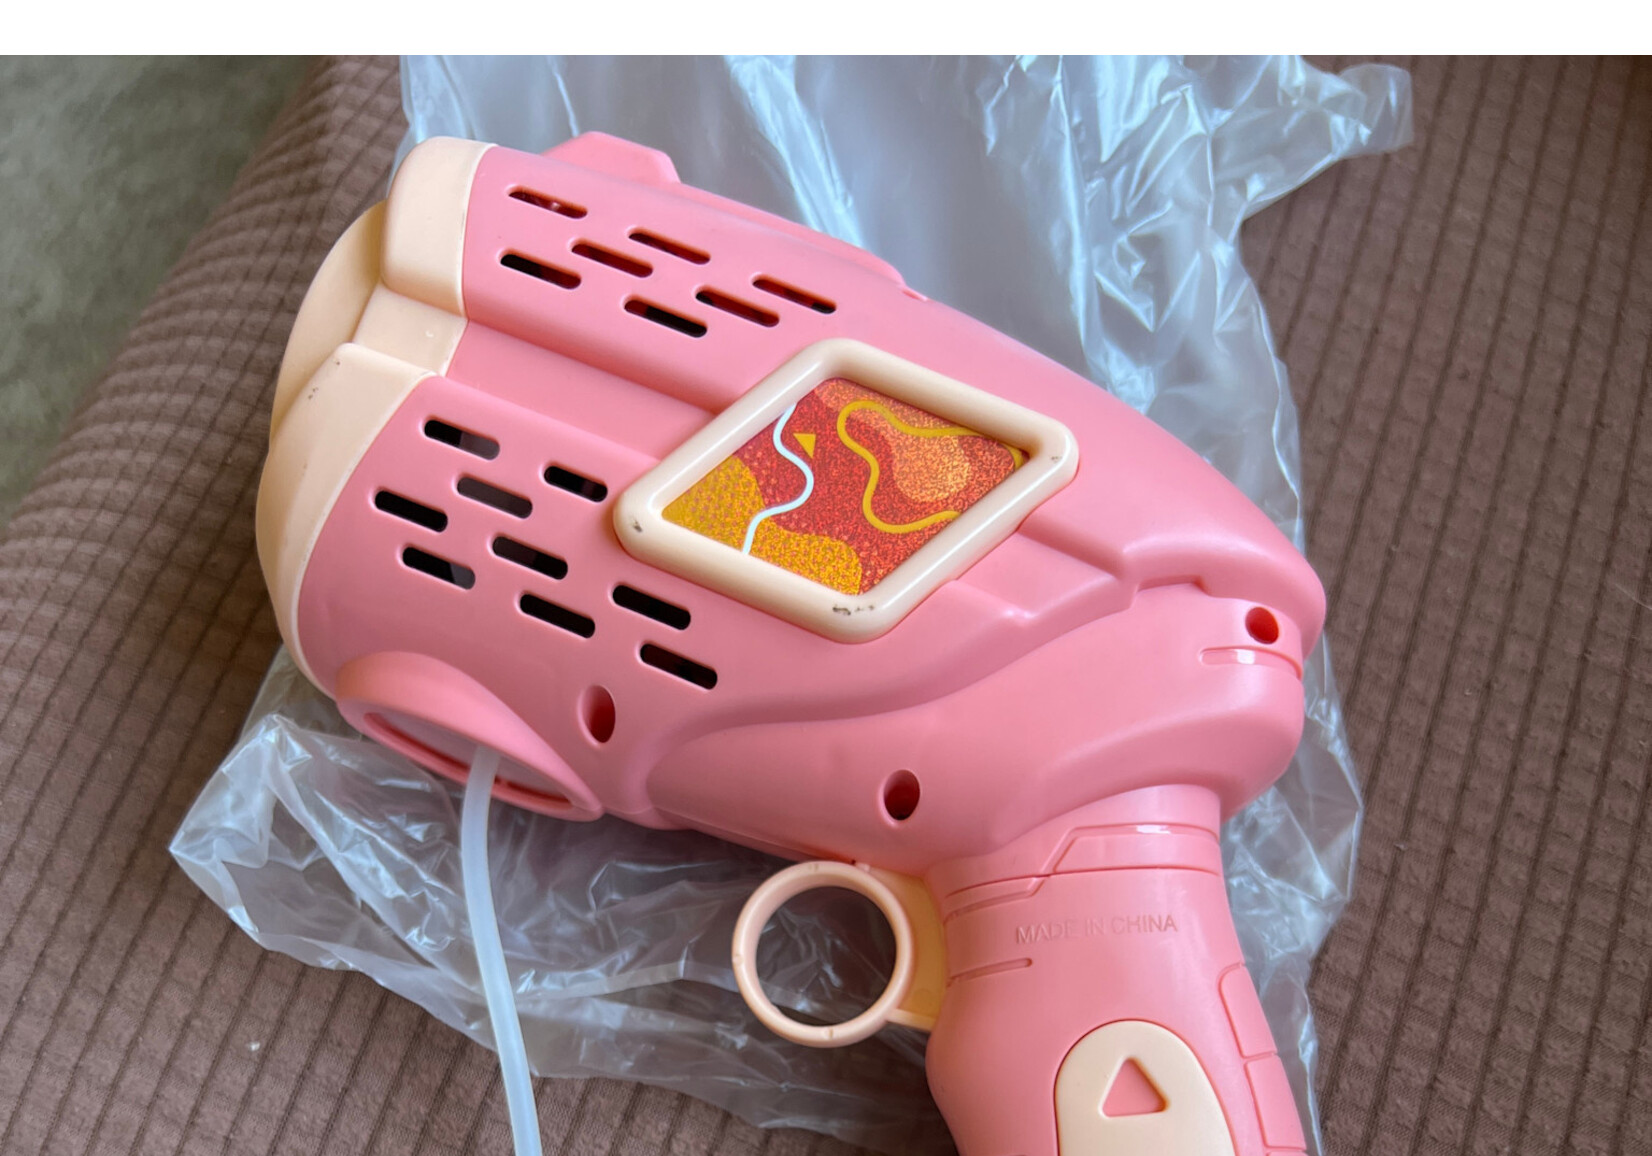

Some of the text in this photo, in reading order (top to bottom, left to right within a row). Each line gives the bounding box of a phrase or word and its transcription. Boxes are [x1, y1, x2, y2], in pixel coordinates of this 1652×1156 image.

[1014, 913, 1178, 945] MADE IN CHINA
